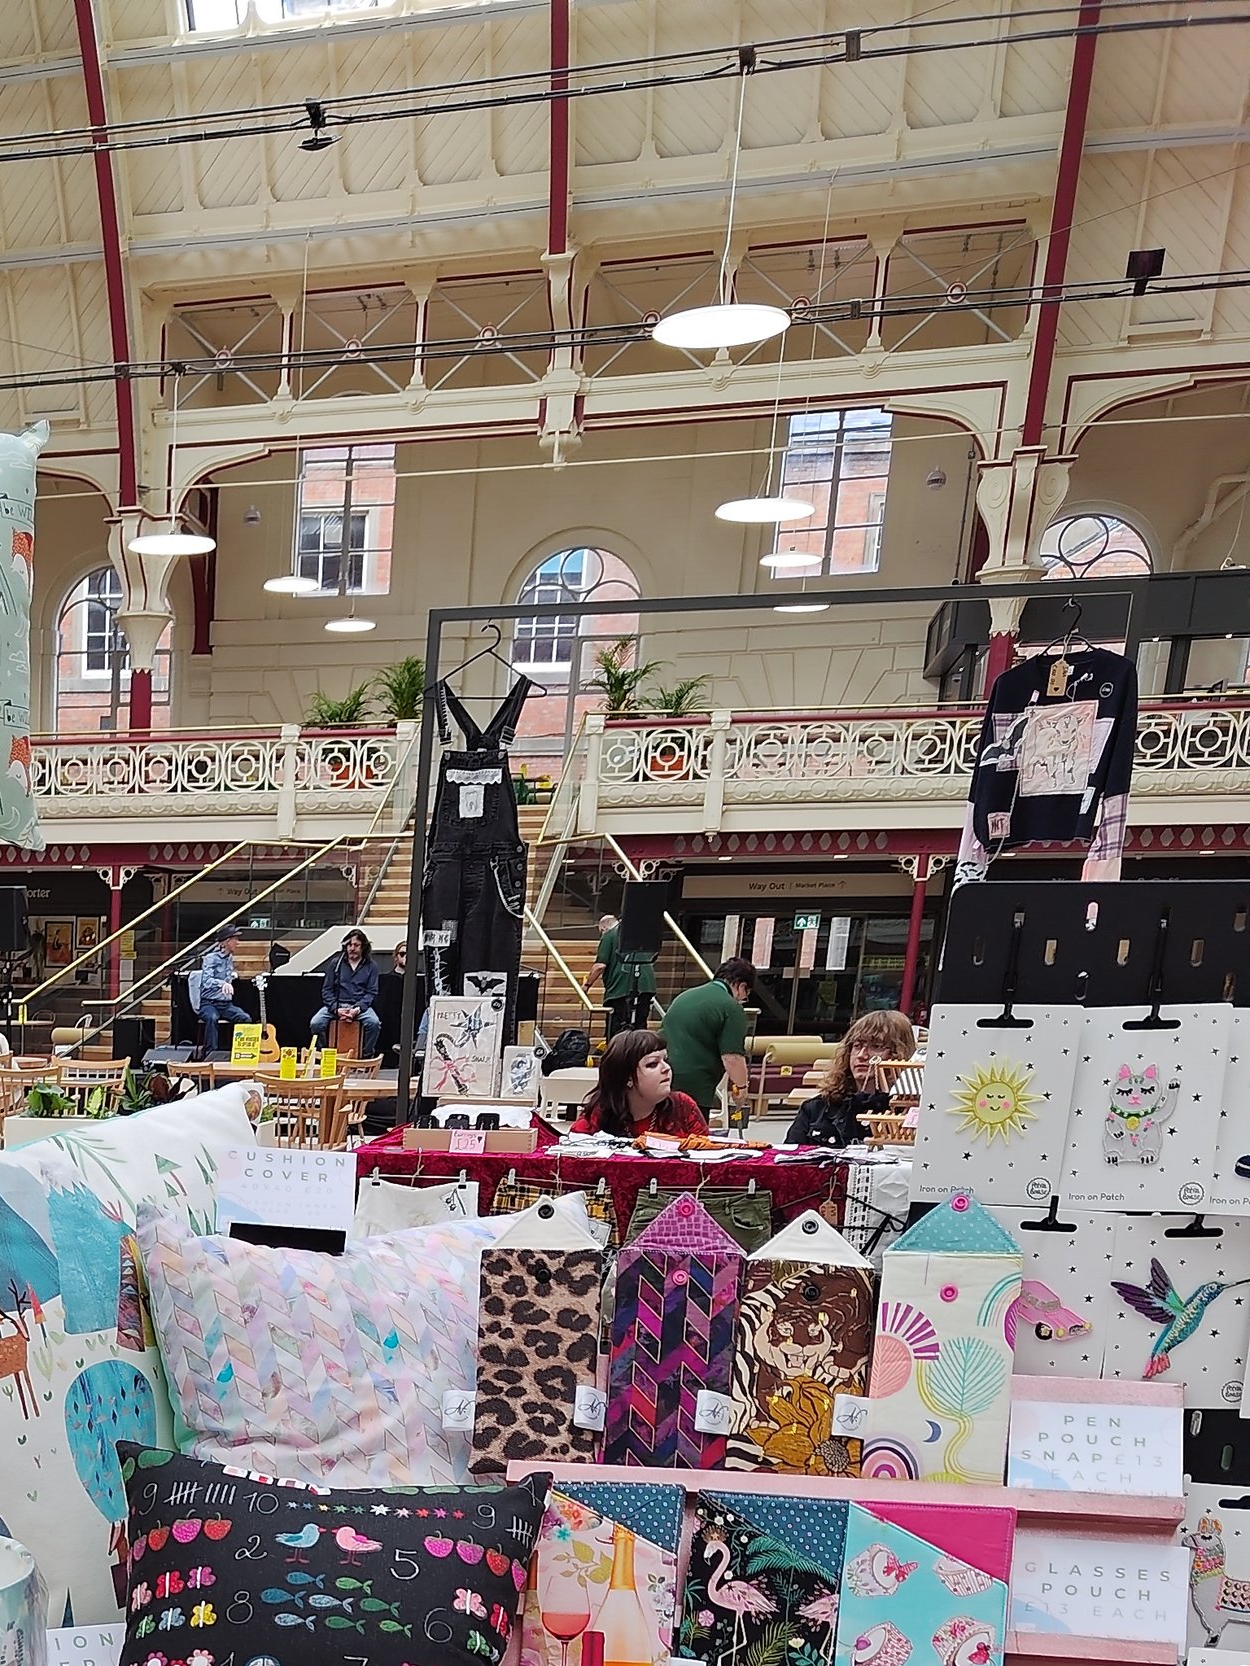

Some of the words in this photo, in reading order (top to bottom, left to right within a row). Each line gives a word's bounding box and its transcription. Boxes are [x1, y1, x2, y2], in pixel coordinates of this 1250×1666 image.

[26, 887, 51, 899] orter
[749, 882, 767, 892] Way
[768, 882, 785, 890] Out
[228, 1150, 345, 1167] CUSHION
[244, 1167, 328, 1183] COVER
[919, 1184, 938, 1193] Iron
[939, 1186, 949, 1194] on
[1068, 1192, 1086, 1201] Iron
[1100, 1194, 1125, 1203] Patch
[1209, 1196, 1227, 1205] Iron
[1063, 1415, 1121, 1428] PEN
[1038, 1432, 1146, 1448] POUCH
[1051, 1469, 1132, 1484] EACH
[143, 1482, 160, 1515] 9
[246, 1492, 280, 1514] 10
[473, 1504, 496, 1529] 9
[234, 1535, 268, 1561] 2
[389, 1548, 420, 1581] 5
[1024, 1561, 1170, 1582] GLASSES
[1041, 1583, 1150, 1601] POUCH
[226, 1590, 254, 1625] 8
[1025, 1602, 1069, 1615] £13
[1093, 1606, 1167, 1623] EACH
[423, 1608, 453, 1645] 6
